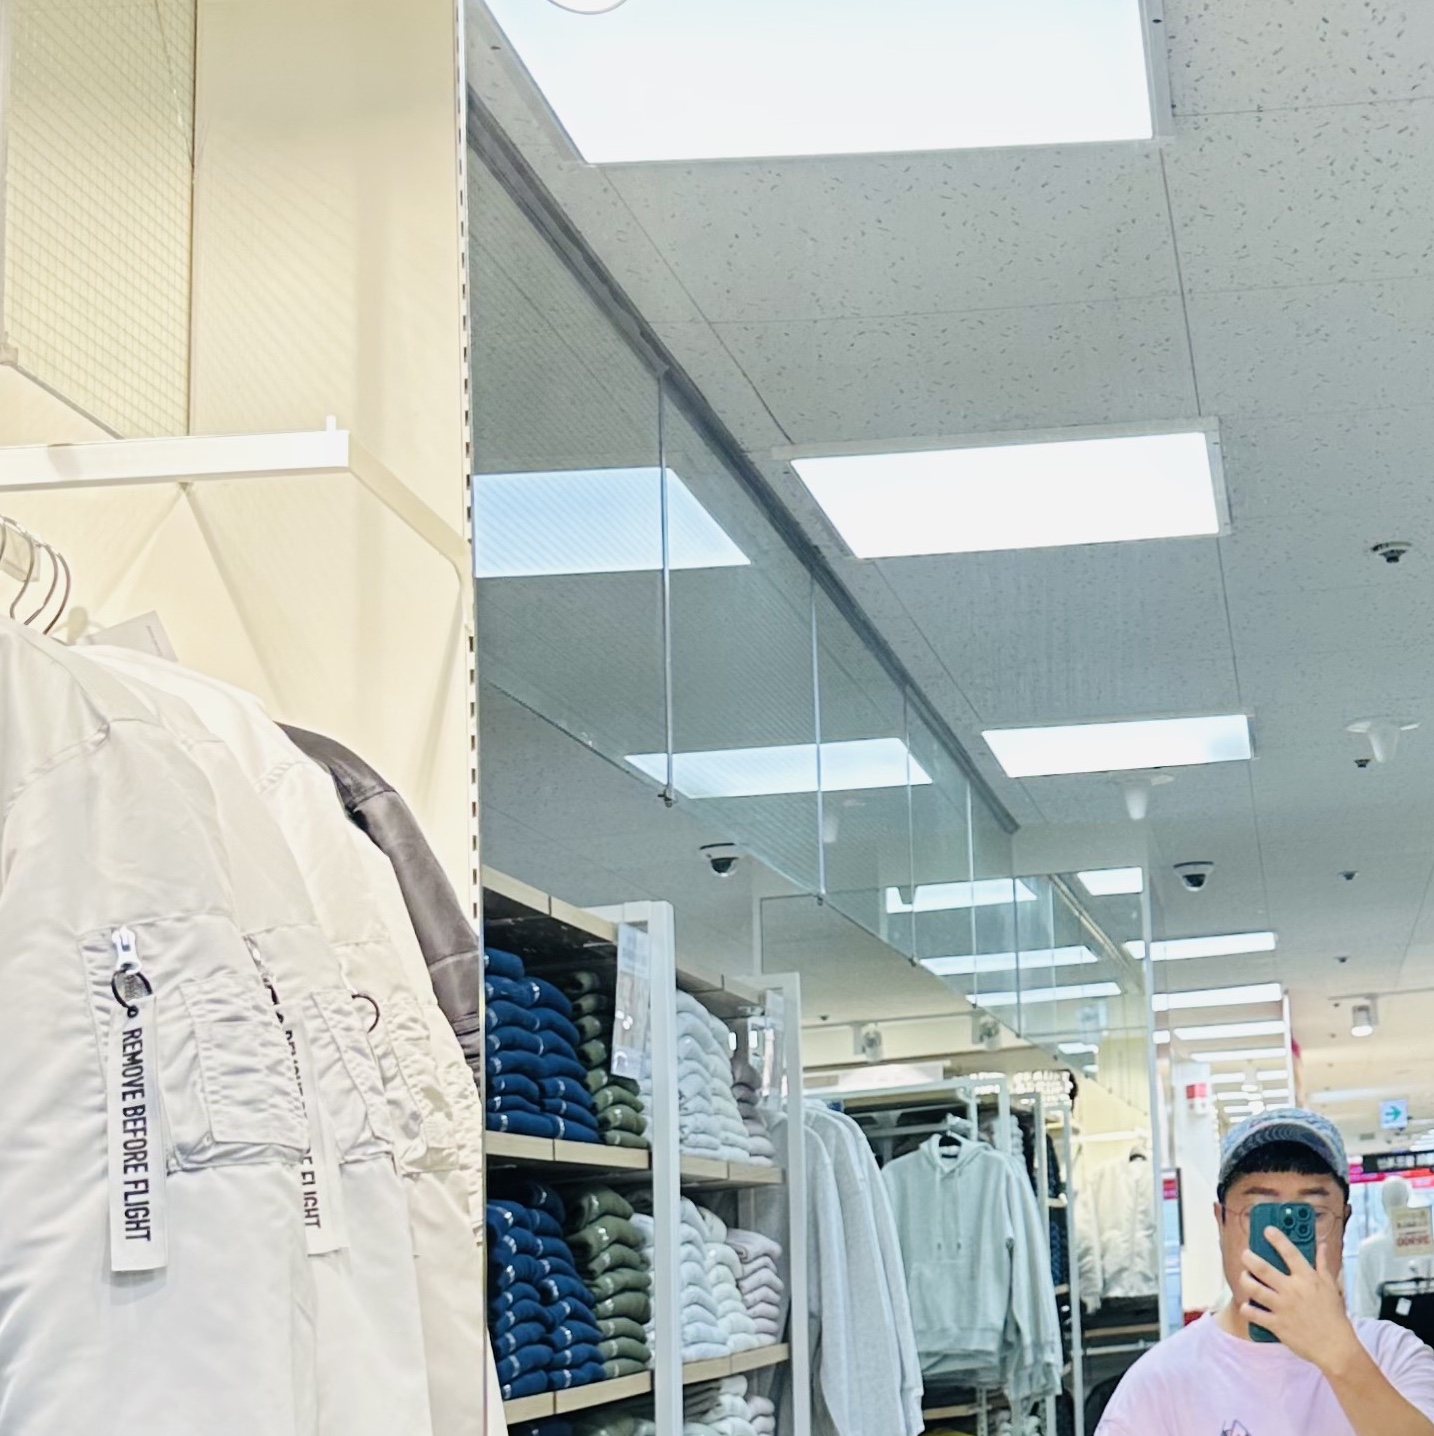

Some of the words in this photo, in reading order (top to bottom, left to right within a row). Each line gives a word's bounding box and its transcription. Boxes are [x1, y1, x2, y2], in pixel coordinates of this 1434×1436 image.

[122, 1028, 145, 1101] REMOVE
[122, 1104, 149, 1174] BEFORE
[123, 1179, 151, 1241] FLIGHT
